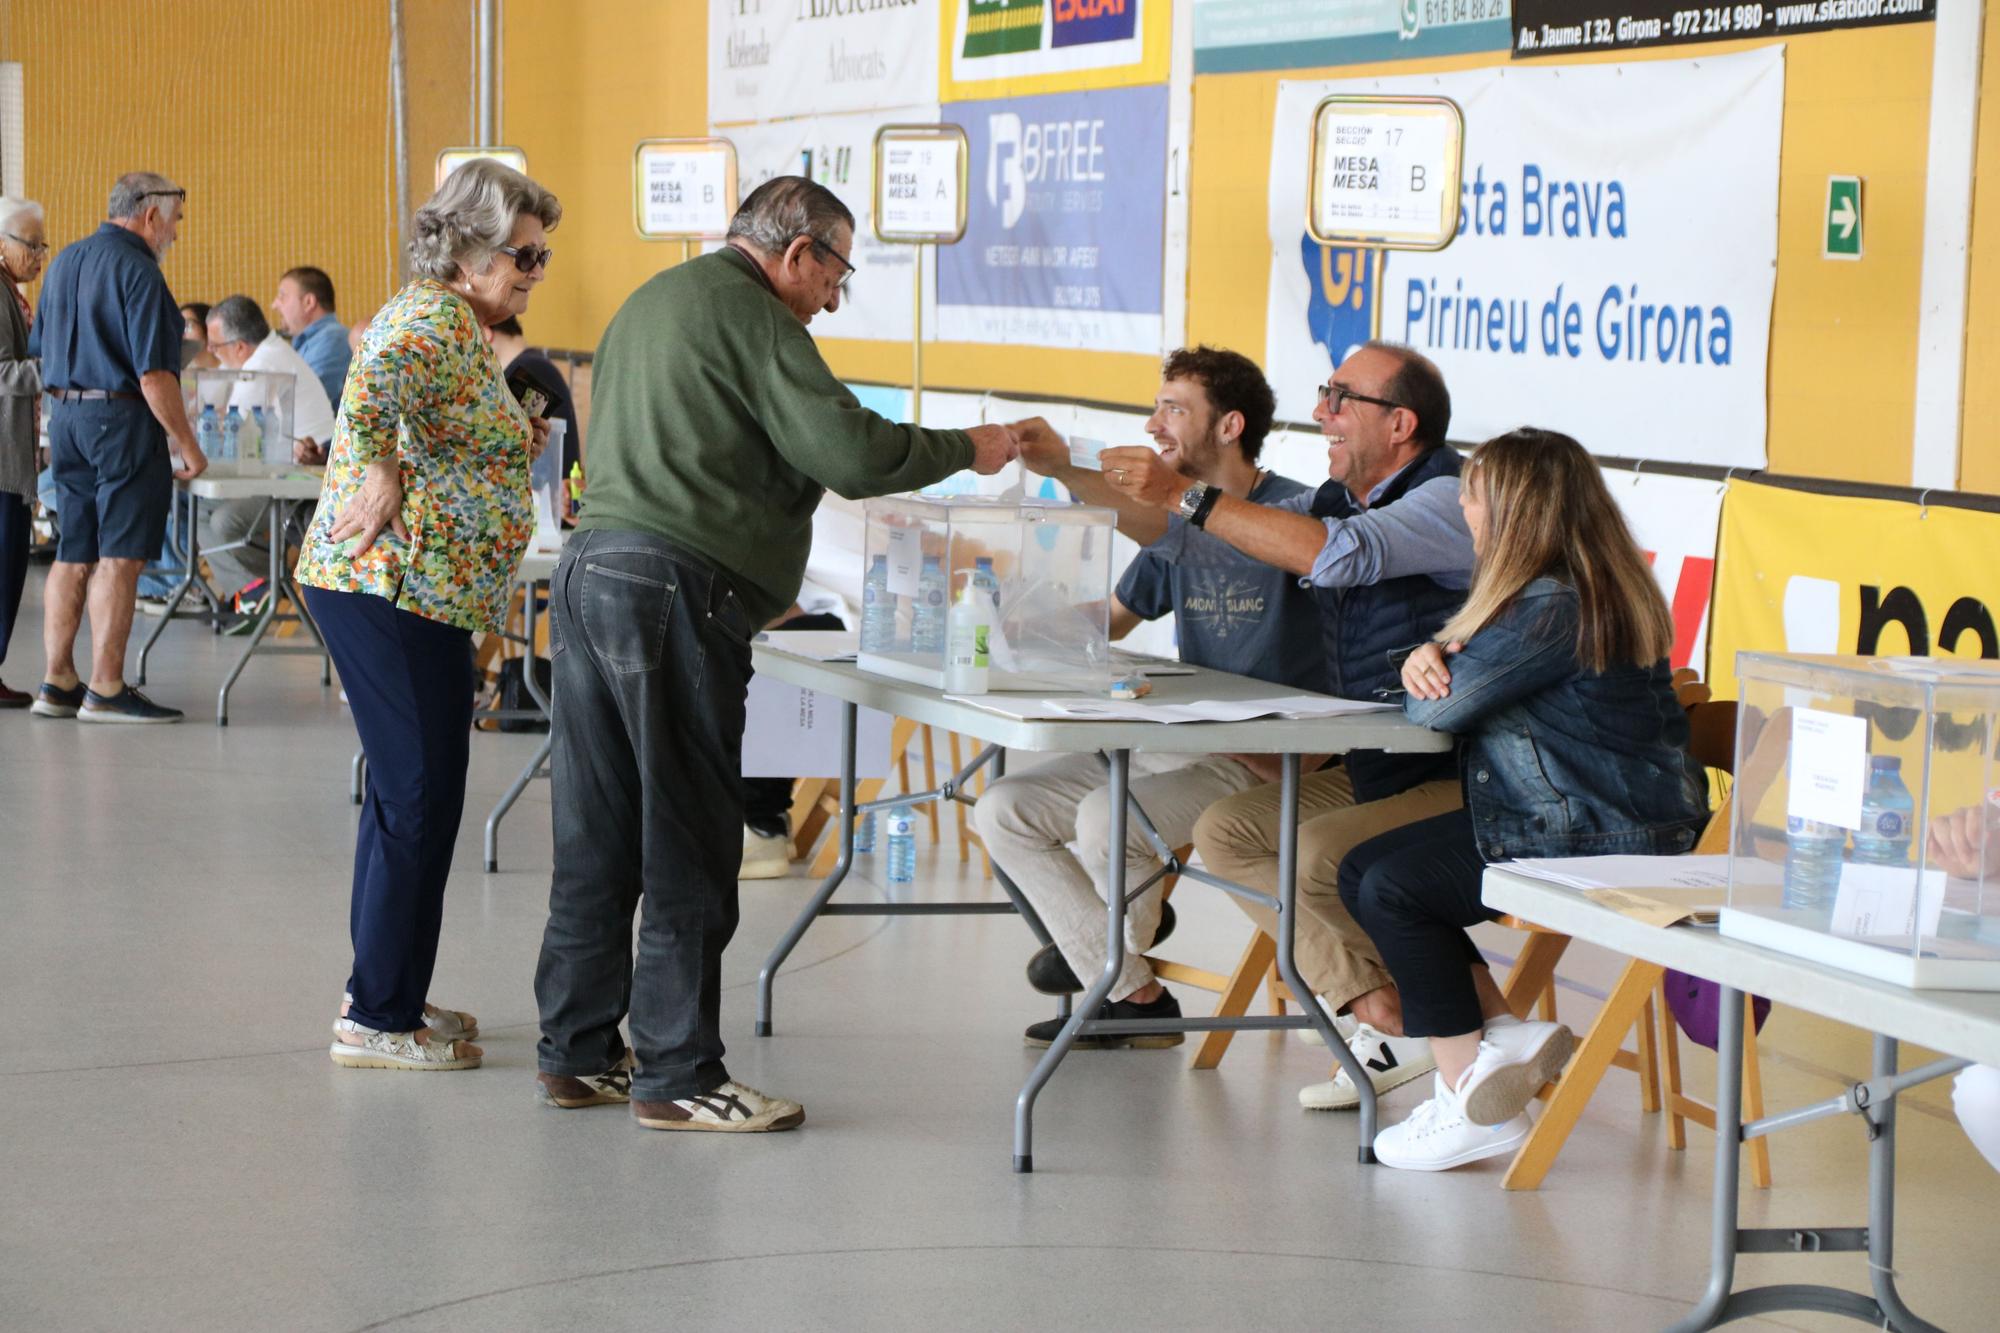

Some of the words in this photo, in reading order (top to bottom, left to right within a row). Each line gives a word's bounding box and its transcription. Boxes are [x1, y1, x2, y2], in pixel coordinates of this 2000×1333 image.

[1426, 0, 1448, 25] 616
[1452, 0, 1466, 22] 84
[1518, 26, 1539, 50] Av.
[1540, 23, 1582, 48] Jaume
[1593, 18, 1615, 45] 32,
[1617, 15, 1662, 42] Girona
[1672, 9, 1700, 37] 972
[1703, 6, 1731, 34] 214
[1733, 3, 1763, 31] 980
[1776, 0, 1924, 27] www.skatidor.com
[1385, 128, 1404, 147] 17
[1023, 119, 1105, 184] BFREE
[1334, 156, 1380, 172] MESA
[650, 181, 683, 192] MESA
[888, 173, 918, 185] MESA
[1332, 173, 1379, 190] MESA
[1410, 164, 1427, 192] B
[703, 184, 715, 204] B
[888, 187, 918, 199] MESA
[935, 177, 947, 199] A
[650, 192, 683, 204] MESA
[1523, 163, 1628, 239] Brava
[1406, 277, 1528, 355] Pirineu
[1541, 281, 1582, 358] de
[1596, 283, 1733, 366] Girona
[1226, 597, 1264, 612] BLANC
